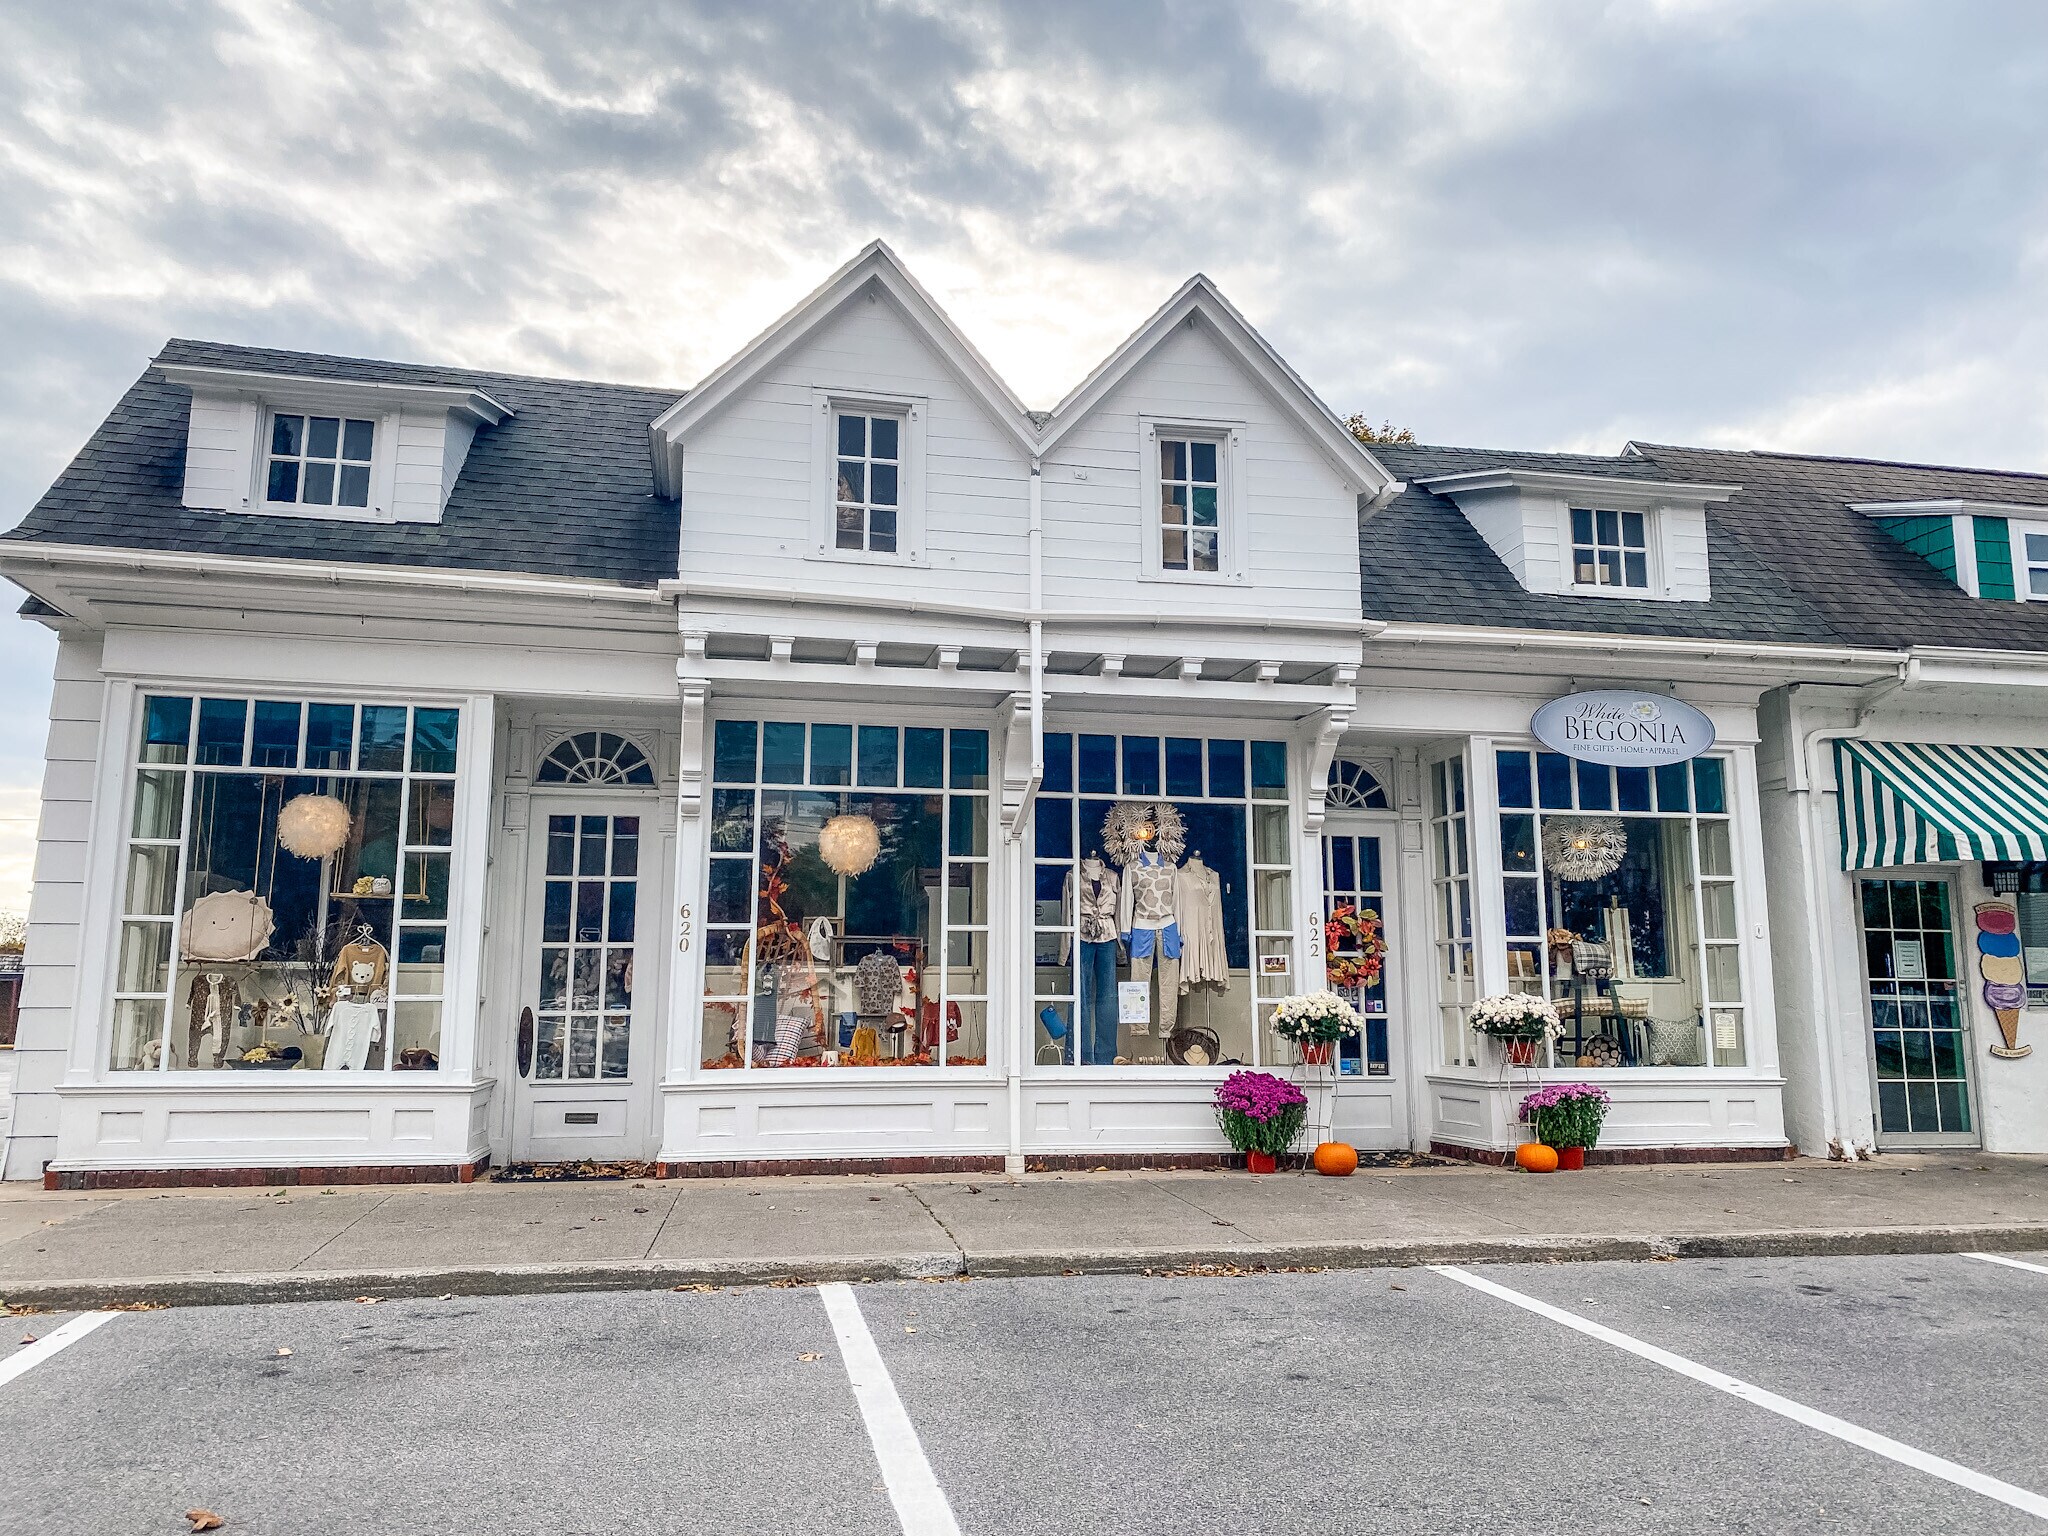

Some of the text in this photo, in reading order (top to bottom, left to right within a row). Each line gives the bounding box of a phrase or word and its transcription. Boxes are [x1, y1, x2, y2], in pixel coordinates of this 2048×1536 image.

[1574, 701, 1626, 721] White
[1564, 716, 1688, 745] BEGONIA
[1573, 743, 1681, 755] FINE GIFTS HOME APPAREL
[679, 903, 691, 953] 620
[1309, 911, 1320, 958] 622
